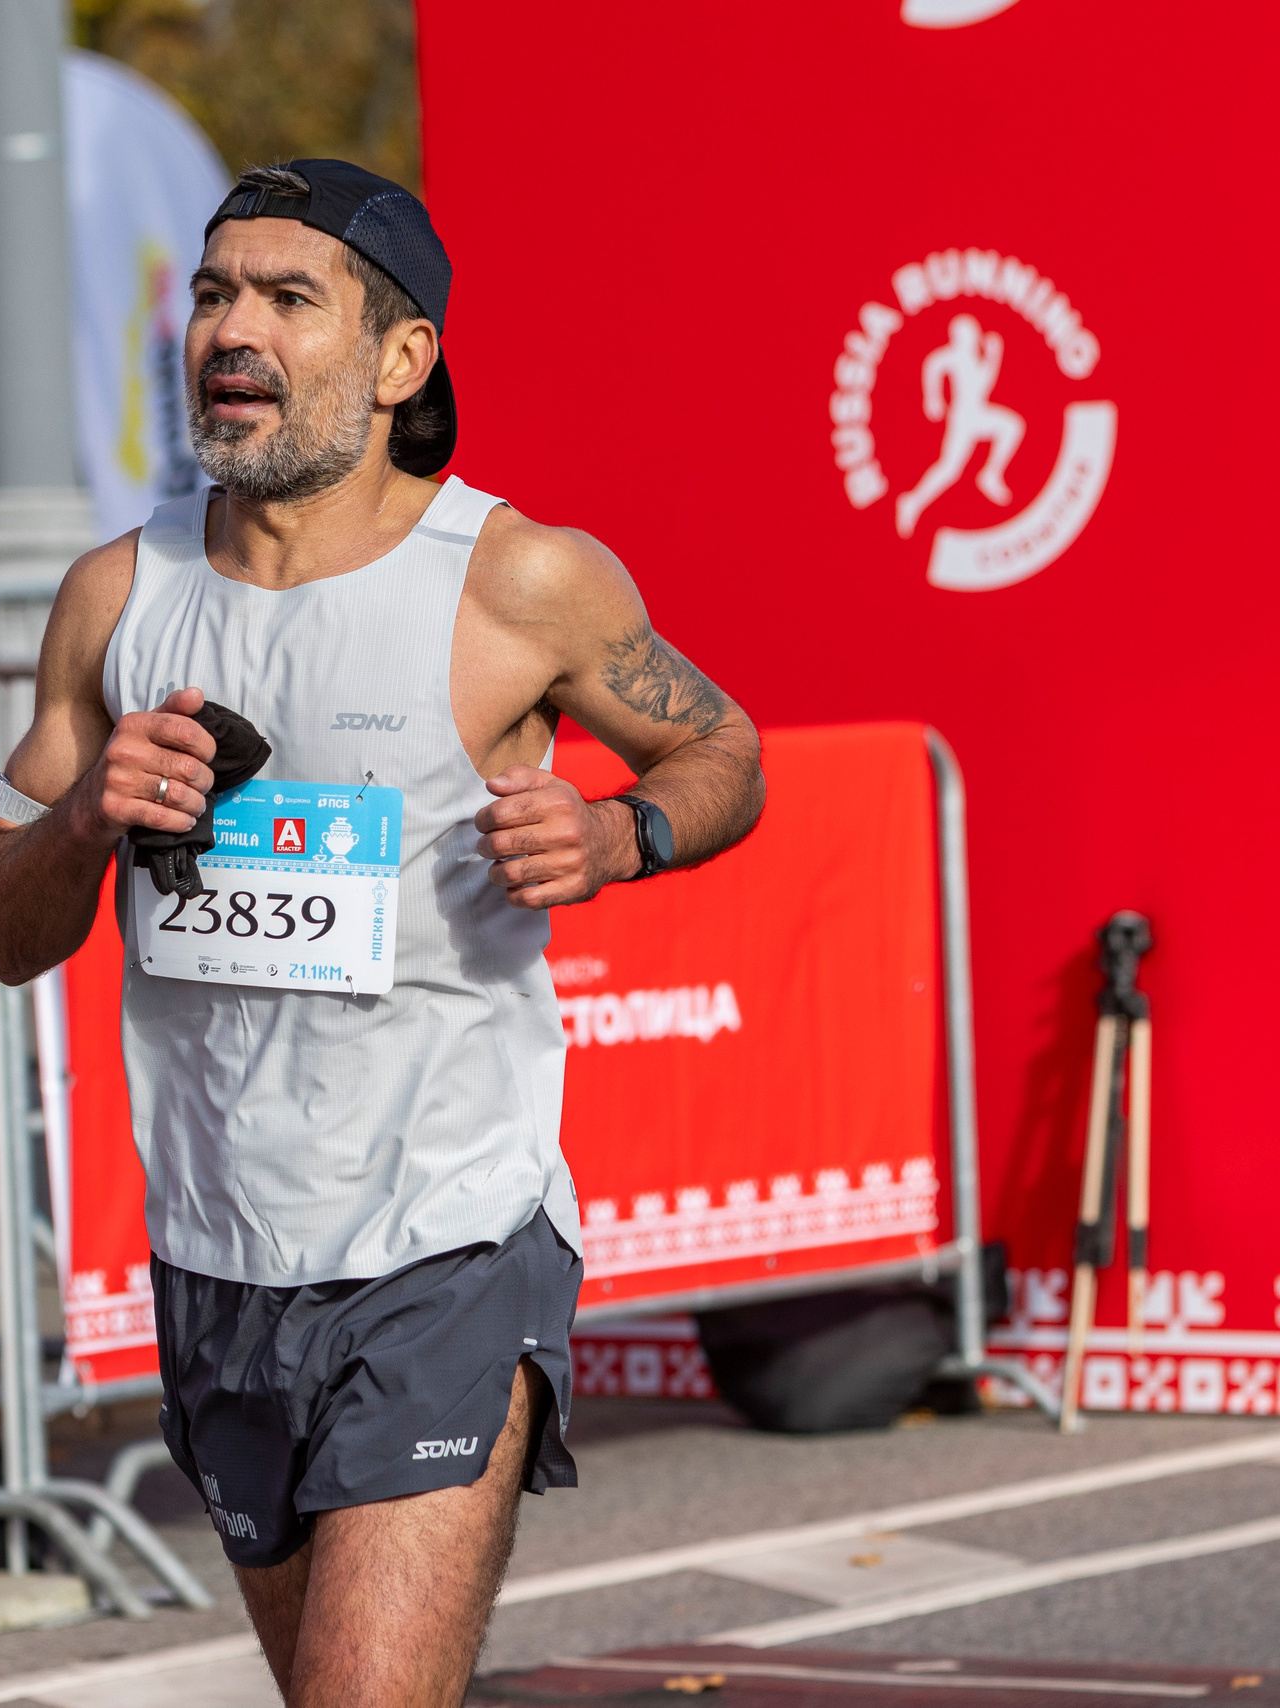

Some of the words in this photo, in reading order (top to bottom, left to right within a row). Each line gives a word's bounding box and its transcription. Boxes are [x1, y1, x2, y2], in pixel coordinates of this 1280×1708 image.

[831, 303, 902, 507] RUSSIA
[328, 798, 350, 809] ПСБ
[379, 816, 388, 857] 04.10.2026
[158, 889, 336, 942] 23839
[371, 907, 384, 961] МОСКВА
